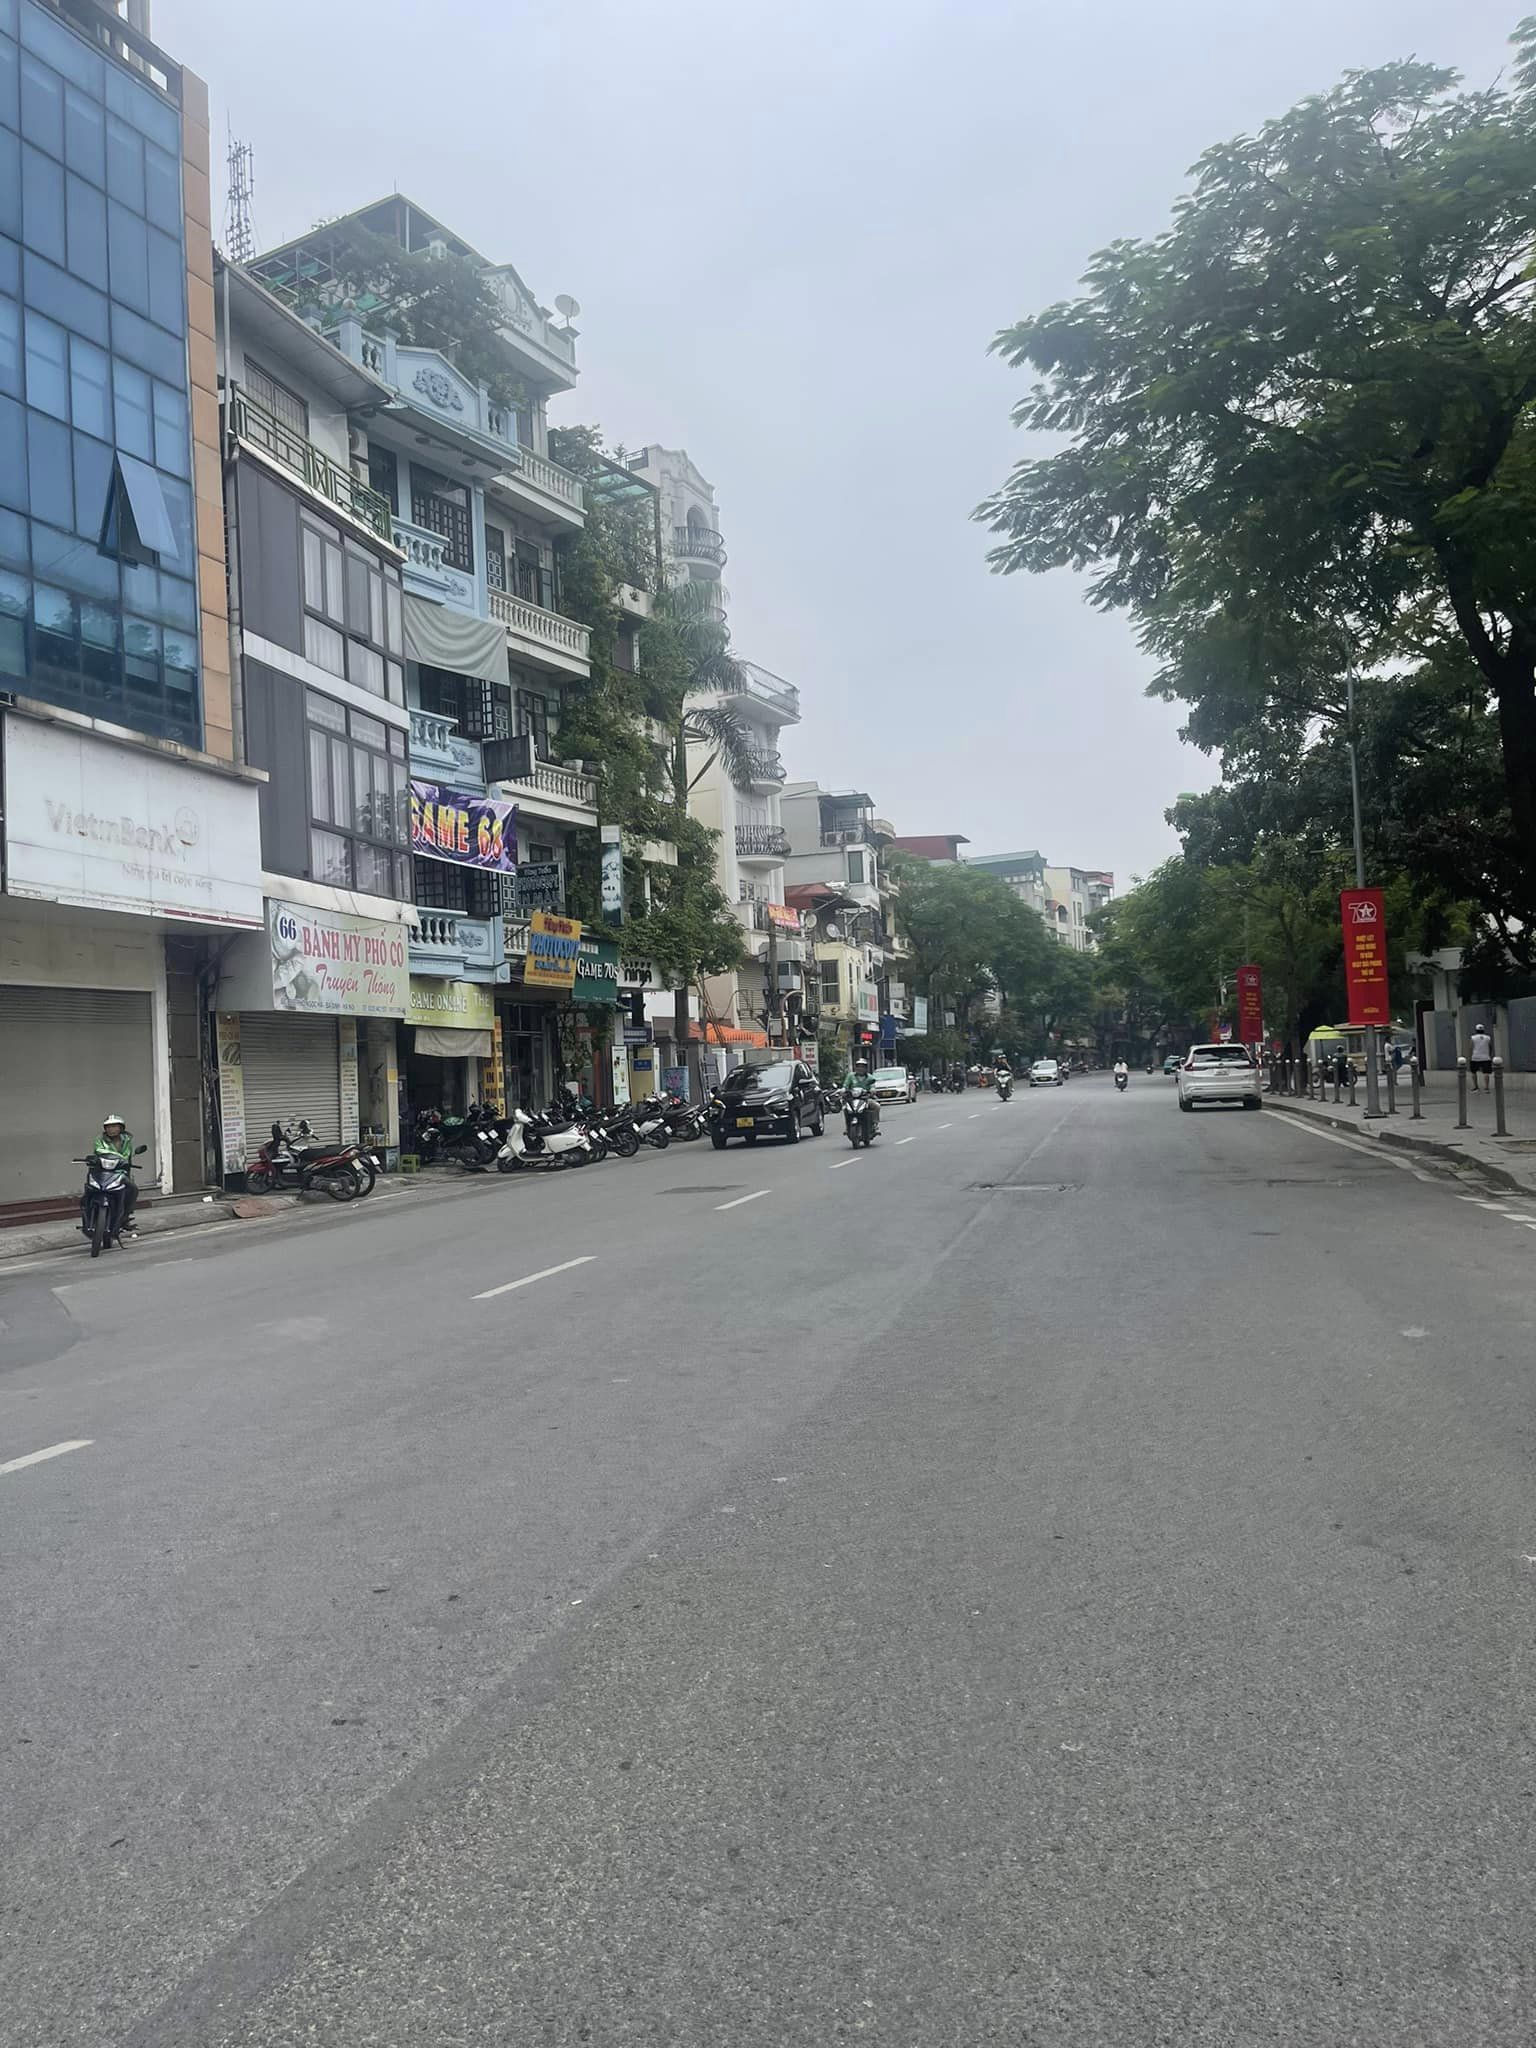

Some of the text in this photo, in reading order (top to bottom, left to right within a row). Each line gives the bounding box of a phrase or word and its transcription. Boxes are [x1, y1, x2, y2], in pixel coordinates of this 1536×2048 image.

[477, 815, 503, 860] 68
[280, 917, 297, 940] 66
[302, 920, 340, 960] BÁNH
[577, 957, 603, 980] GAME
[410, 992, 435, 1010] GAME
